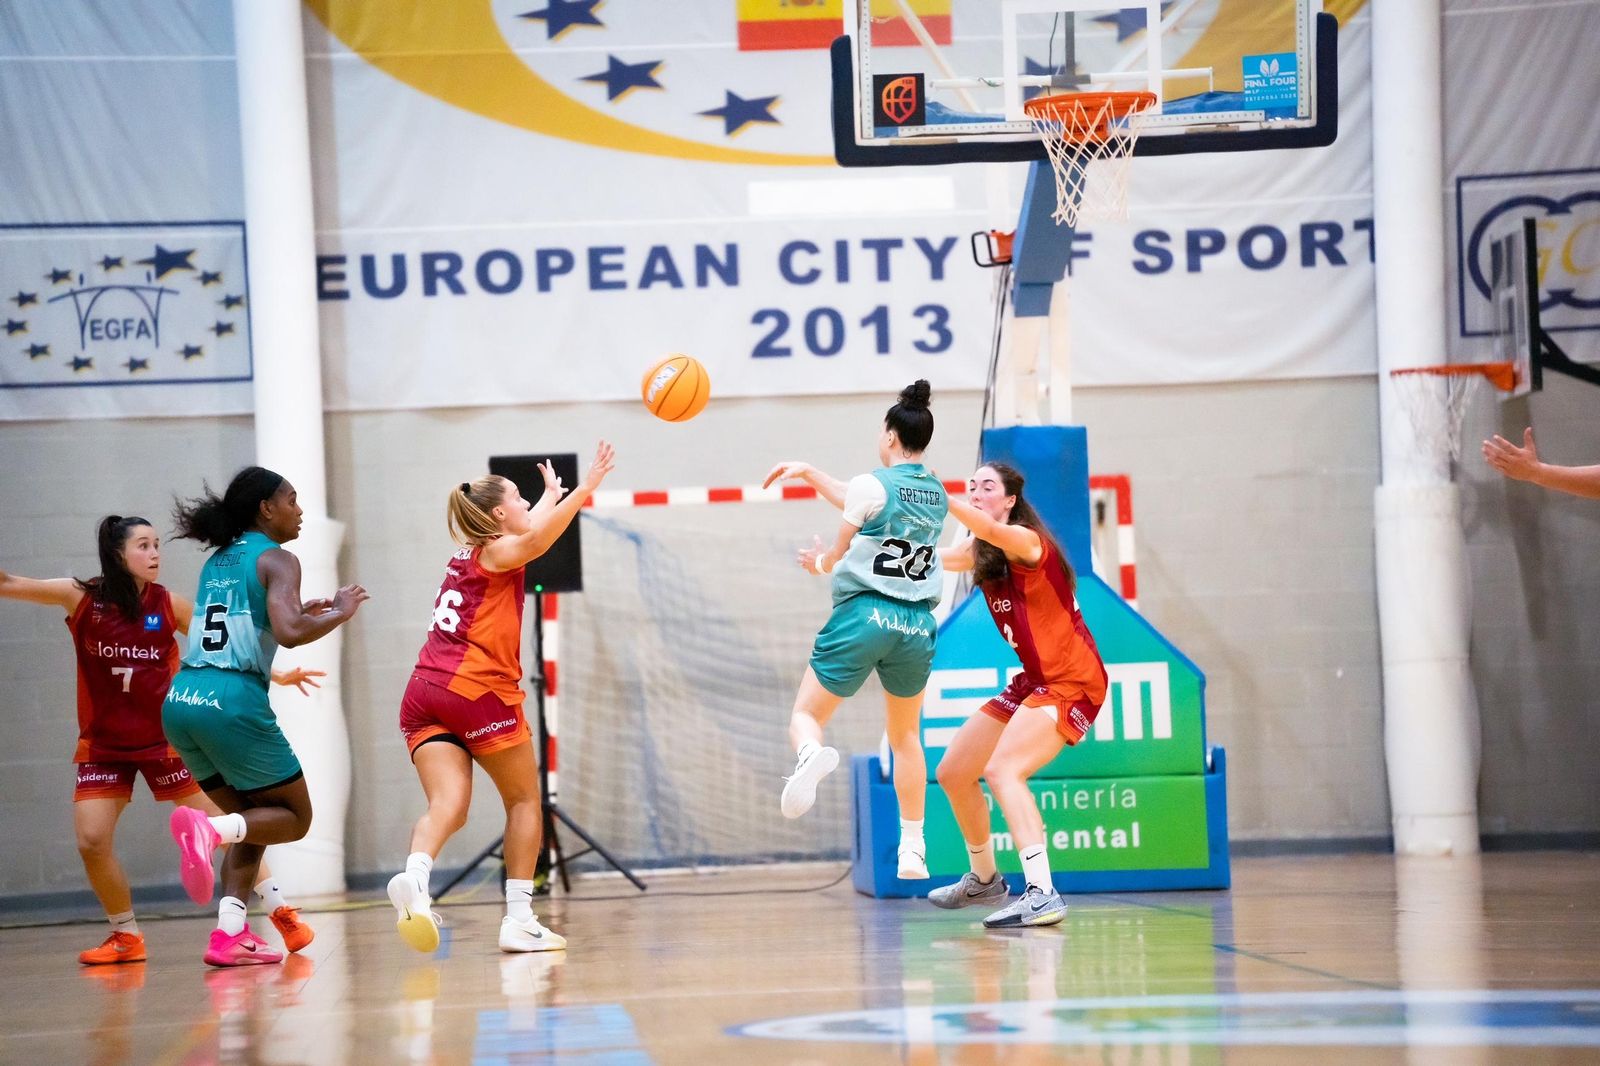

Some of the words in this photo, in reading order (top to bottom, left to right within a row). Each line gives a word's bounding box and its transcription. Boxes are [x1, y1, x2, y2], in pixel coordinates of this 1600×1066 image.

[1269, 76, 1297, 86] FOUR
[316, 243, 740, 301] EUROPEAN
[778, 236, 959, 286] CITY
[90, 318, 152, 341] EGFA
[750, 303, 954, 358] 2013
[899, 487, 940, 506] GRETTER
[872, 537, 934, 583] 20
[200, 602, 230, 654] 5
[428, 586, 464, 634] 6
[98, 641, 160, 660] lointek
[111, 666, 134, 693] 7
